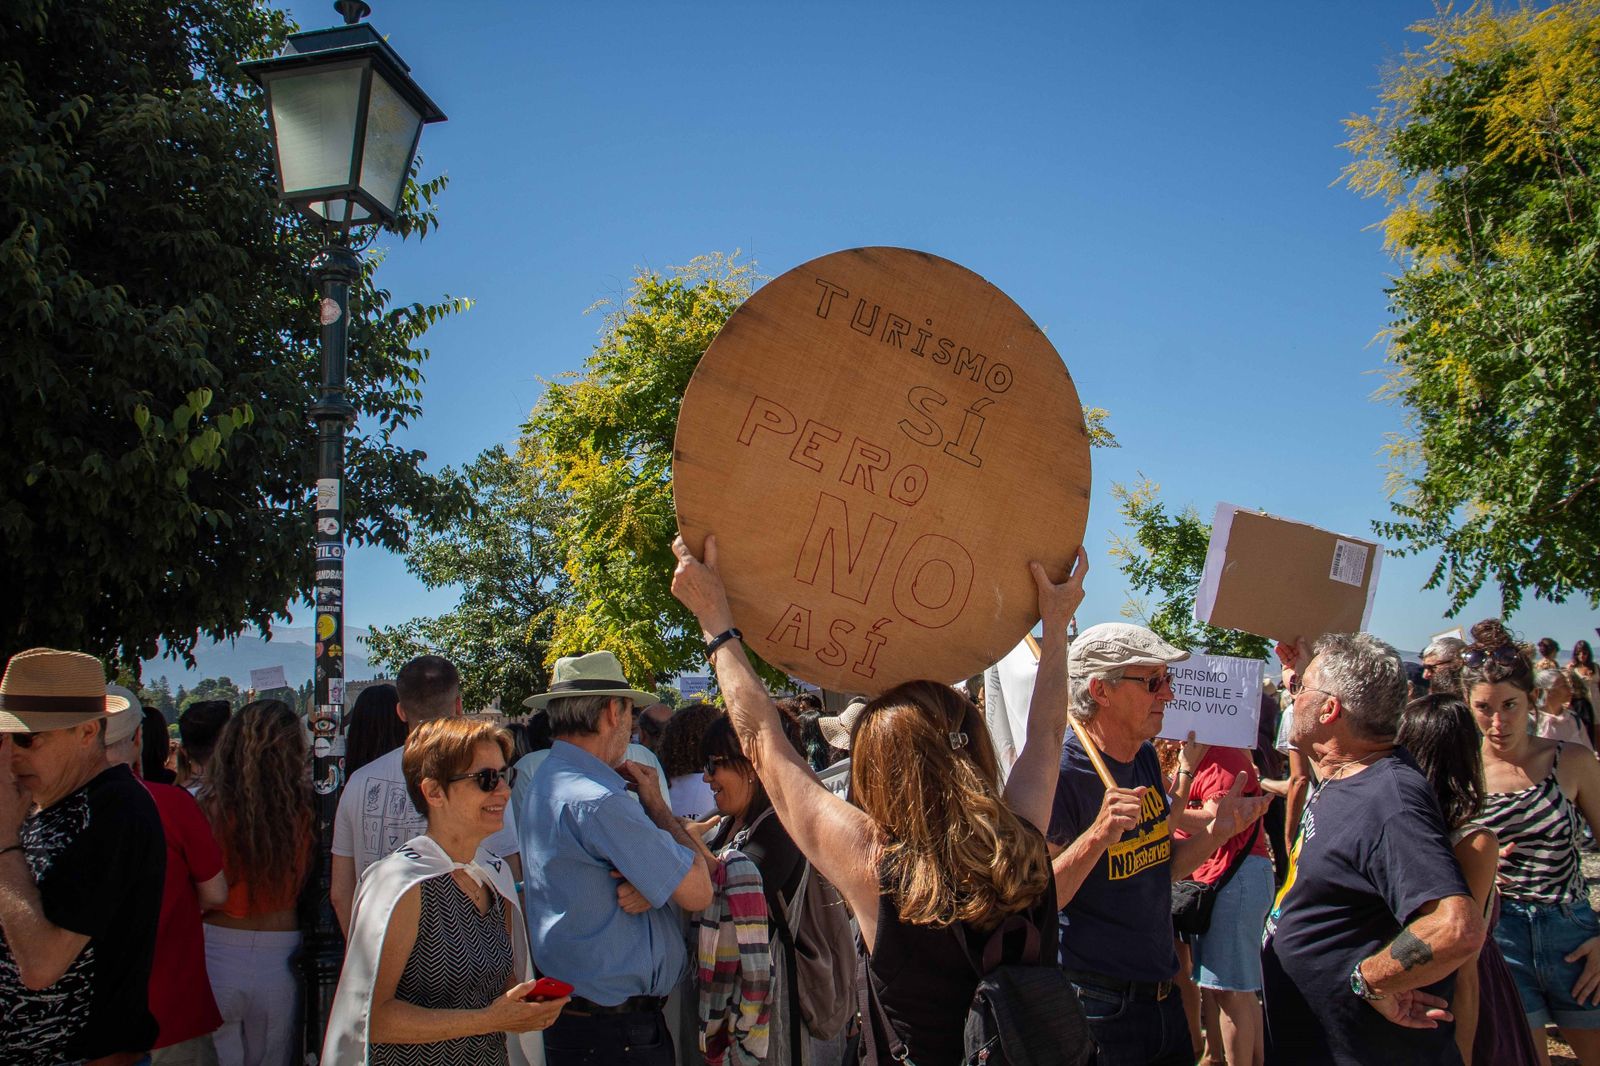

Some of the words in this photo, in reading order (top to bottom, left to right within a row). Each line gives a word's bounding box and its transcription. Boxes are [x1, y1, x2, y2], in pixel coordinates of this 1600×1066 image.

[737, 395, 929, 507] PERO
[898, 385, 995, 468] SÍ
[794, 491, 975, 629] NO
[766, 603, 894, 679] ASÍ
[1205, 702, 1238, 716] VIVO
[1111, 851, 1134, 878] NO
